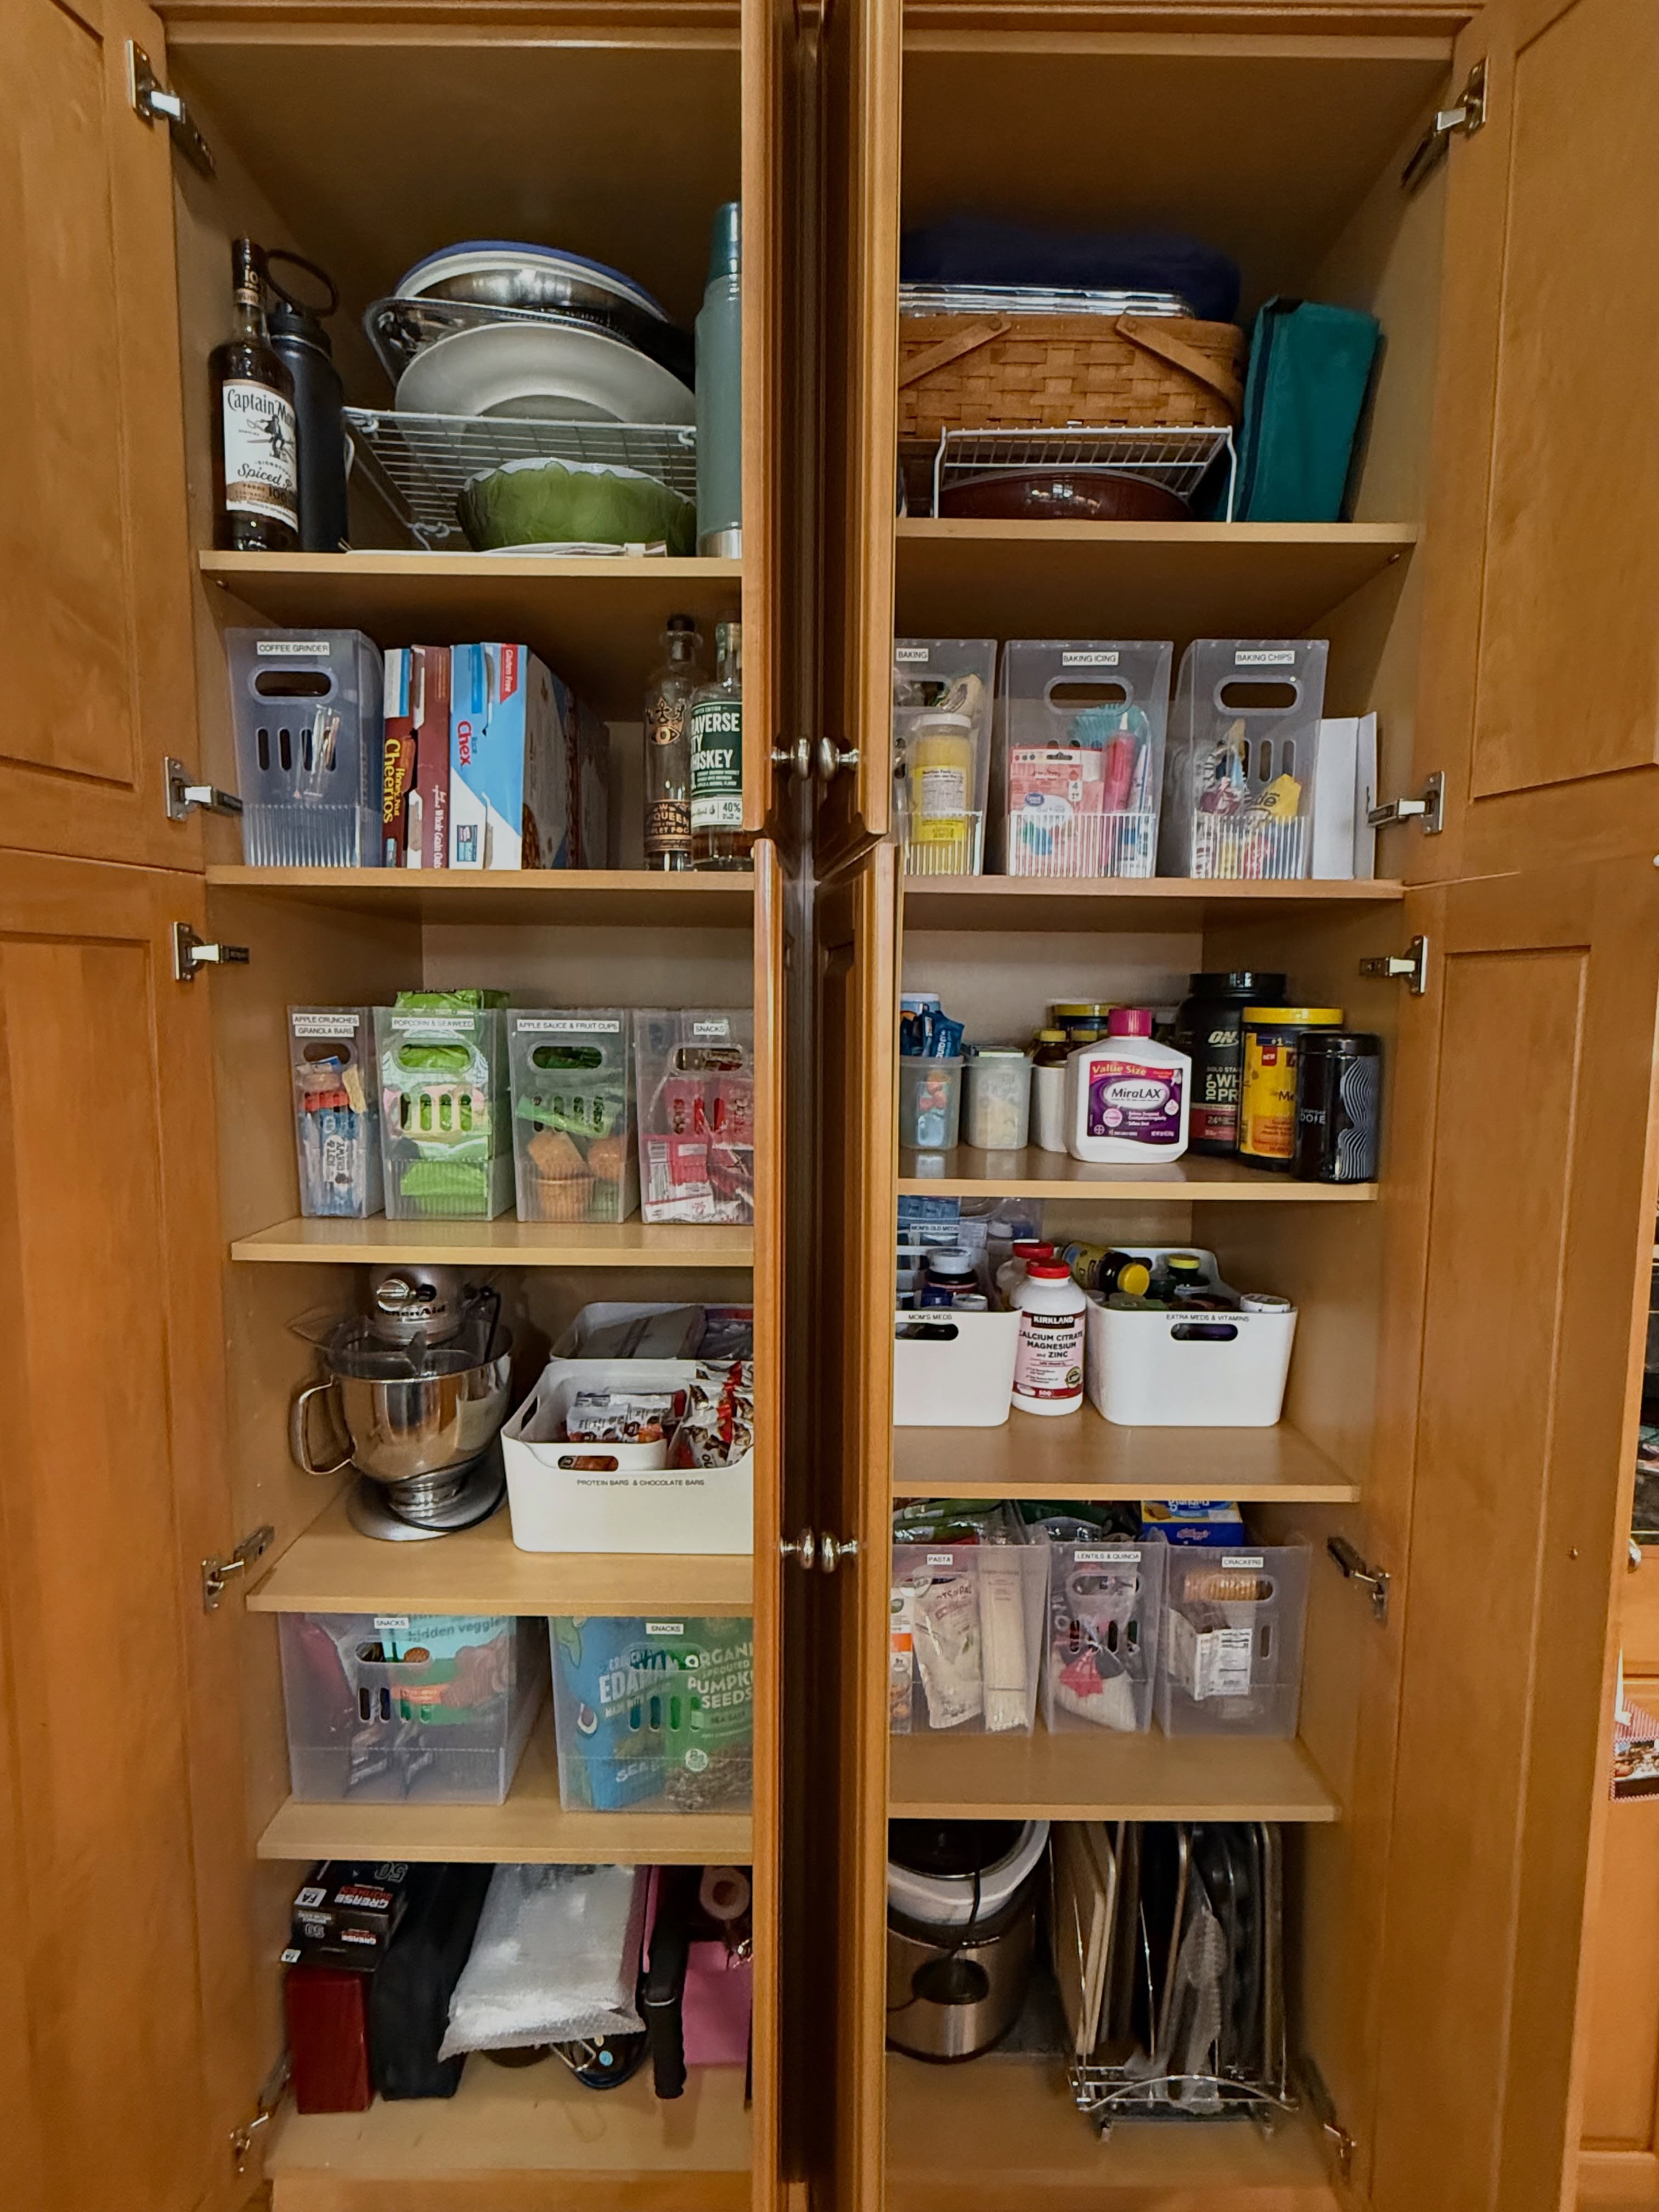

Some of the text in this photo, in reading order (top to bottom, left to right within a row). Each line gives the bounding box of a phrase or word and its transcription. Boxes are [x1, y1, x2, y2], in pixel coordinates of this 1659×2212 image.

[227, 388, 295, 427] Captain Mor
[237, 463, 282, 486] Spiced
[259, 644, 329, 652] COFFEE GRINDER
[899, 651, 928, 659] BAKING
[1063, 654, 1116, 663] BAKING ICING
[691, 713, 740, 735] AVERSE
[458, 720, 472, 766] Chex
[691, 749, 733, 772] HISKEY
[383, 738, 401, 824] Cheerios
[394, 768, 405, 799] Honey
[723, 802, 741, 812] 40%
[433, 832, 444, 851] Grain
[1207, 1031, 1238, 1044] ON
[1092, 1063, 1123, 1074] Value
[1126, 1065, 1147, 1076] Size
[1216, 1073, 1239, 1088] WH
[1111, 1087, 1161, 1099] MiraLAX
[1217, 1088, 1238, 1102] PR
[1033, 1316, 1075, 1324] KIRKLAND
[1019, 1329, 1083, 1341] CALCIUM CITRATE
[1026, 1340, 1076, 1350] MAGNESIUM
[685, 1642, 753, 1668] ORGANI
[687, 1670, 753, 1694] PUMPKI
[701, 1688, 752, 1709] SEEDS
[302, 1894, 319, 1904] FA
[334, 1893, 390, 1910] GREASE
